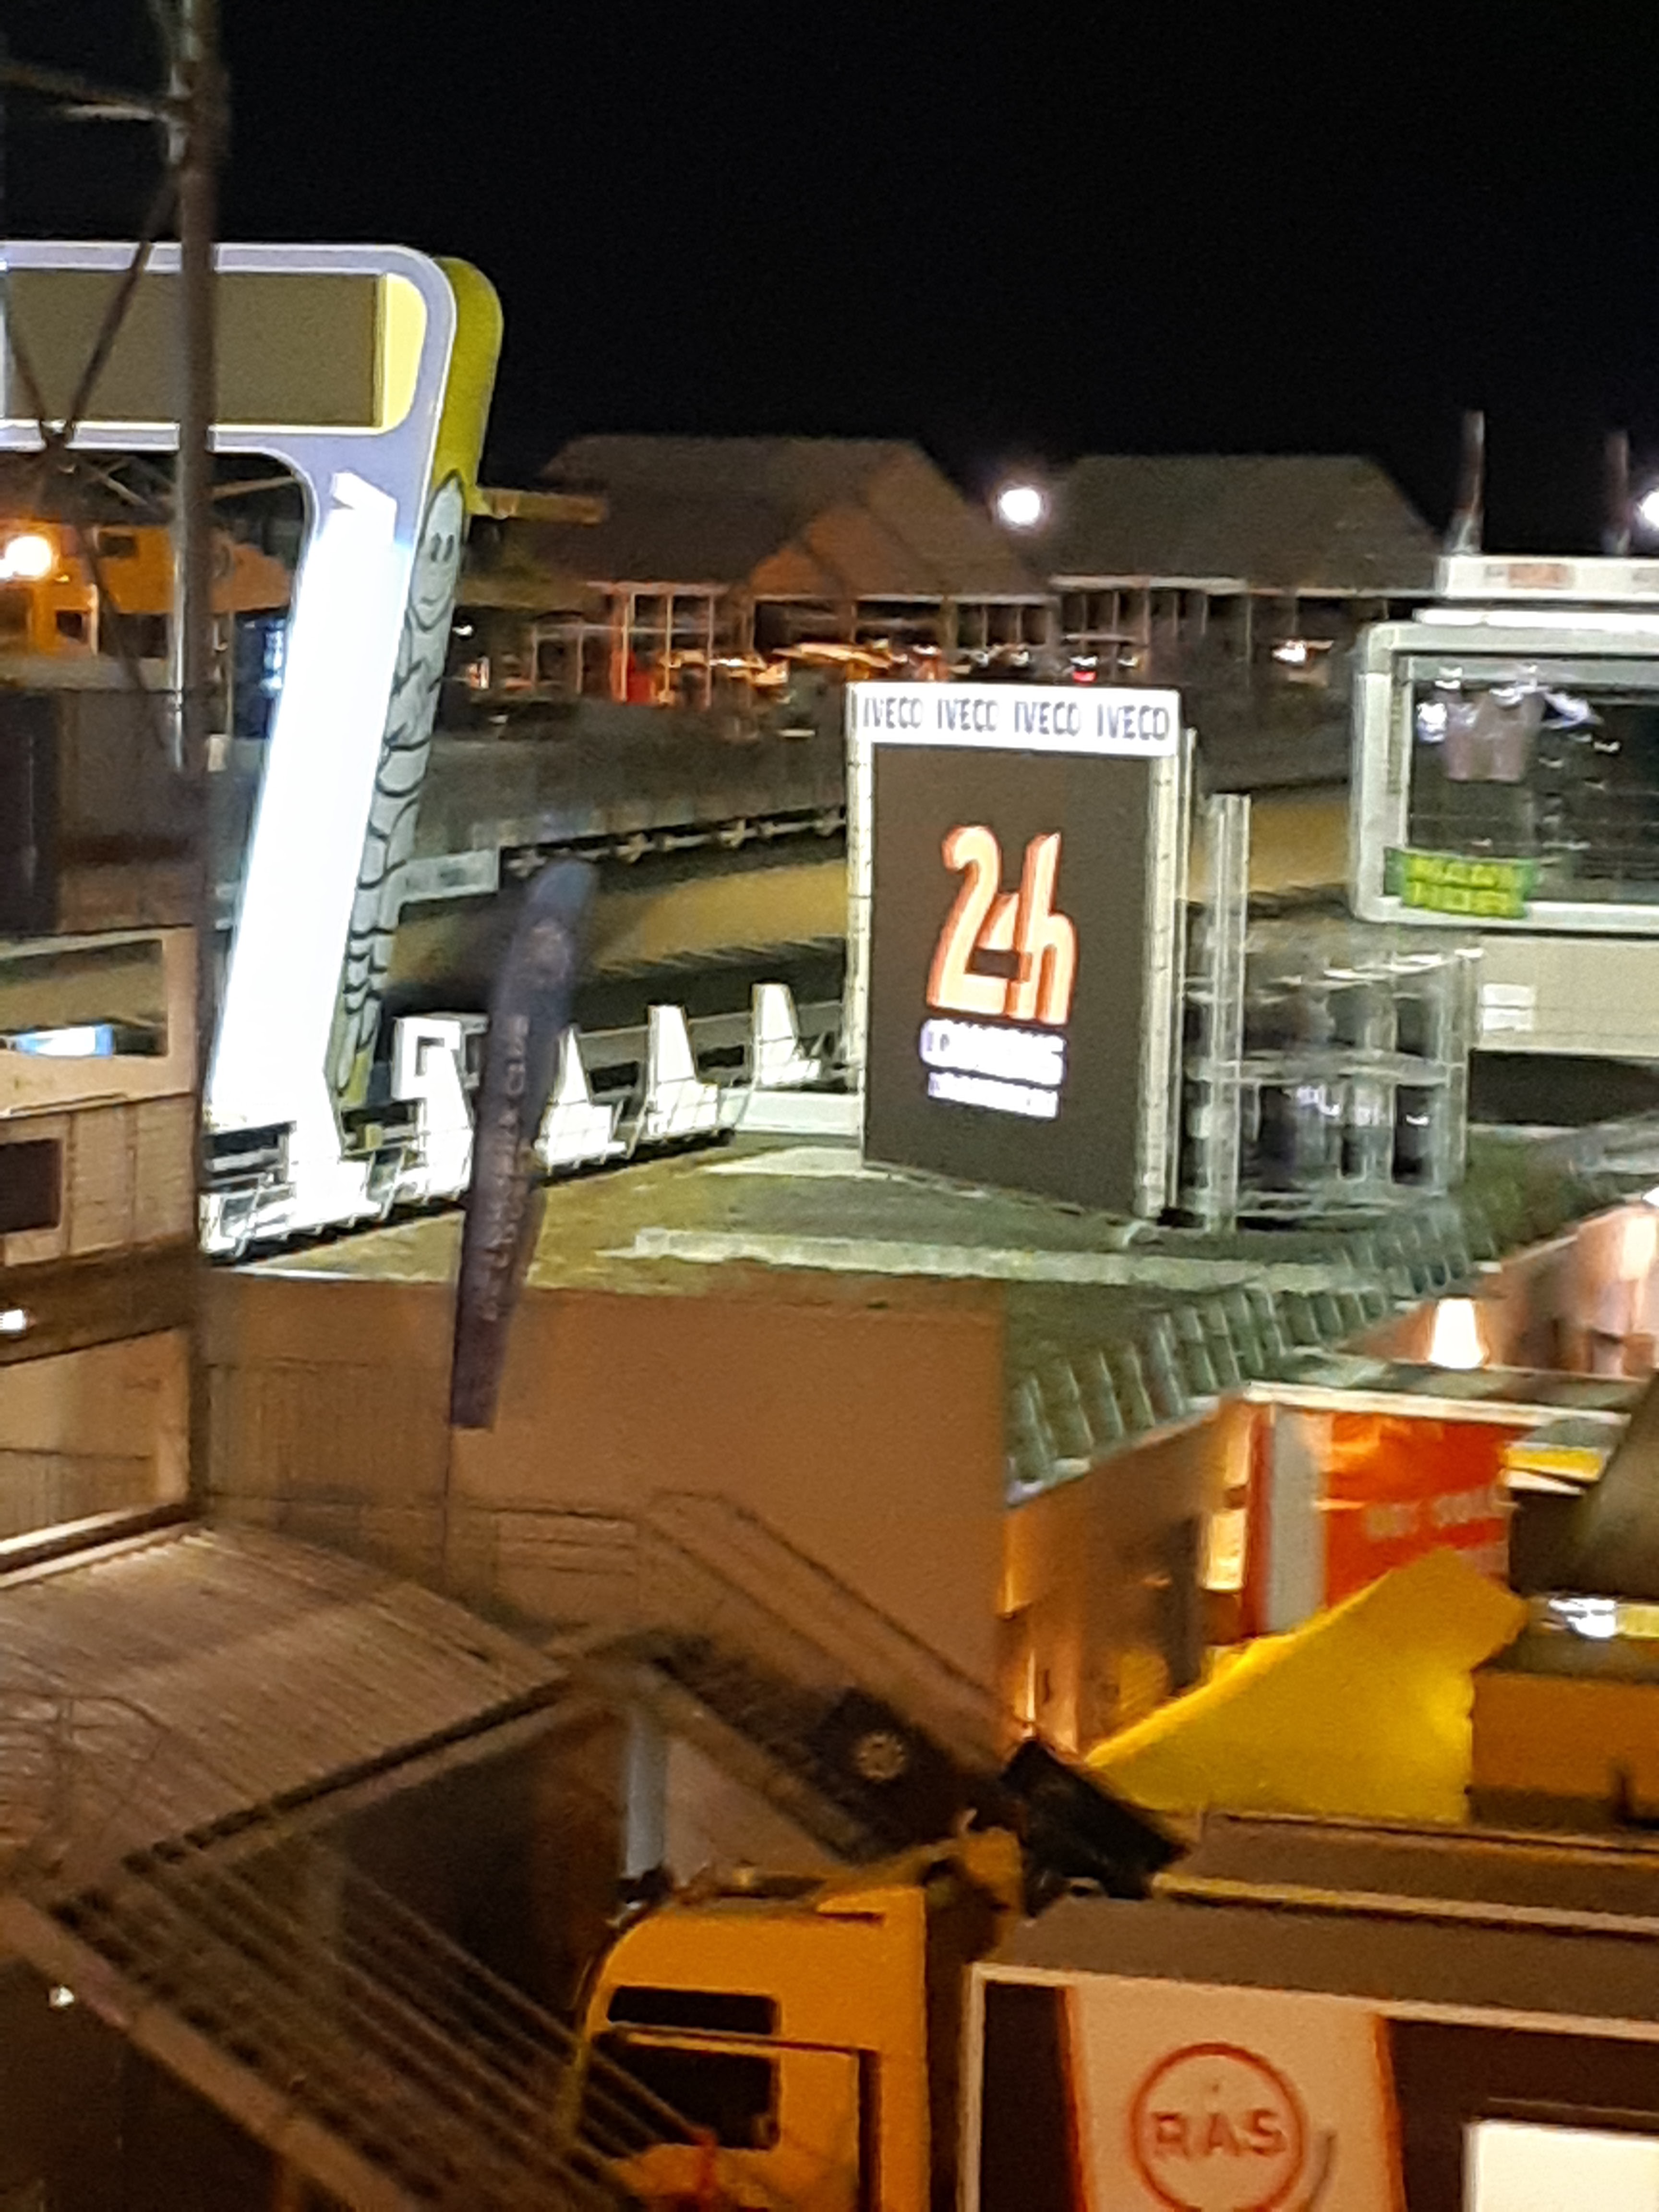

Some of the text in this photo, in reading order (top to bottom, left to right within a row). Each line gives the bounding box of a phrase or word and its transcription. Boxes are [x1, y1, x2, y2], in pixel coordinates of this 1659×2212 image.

[863, 697, 1170, 741] IVECO IVECO IVECO IVECO
[1153, 2109, 1287, 2159] RAS
